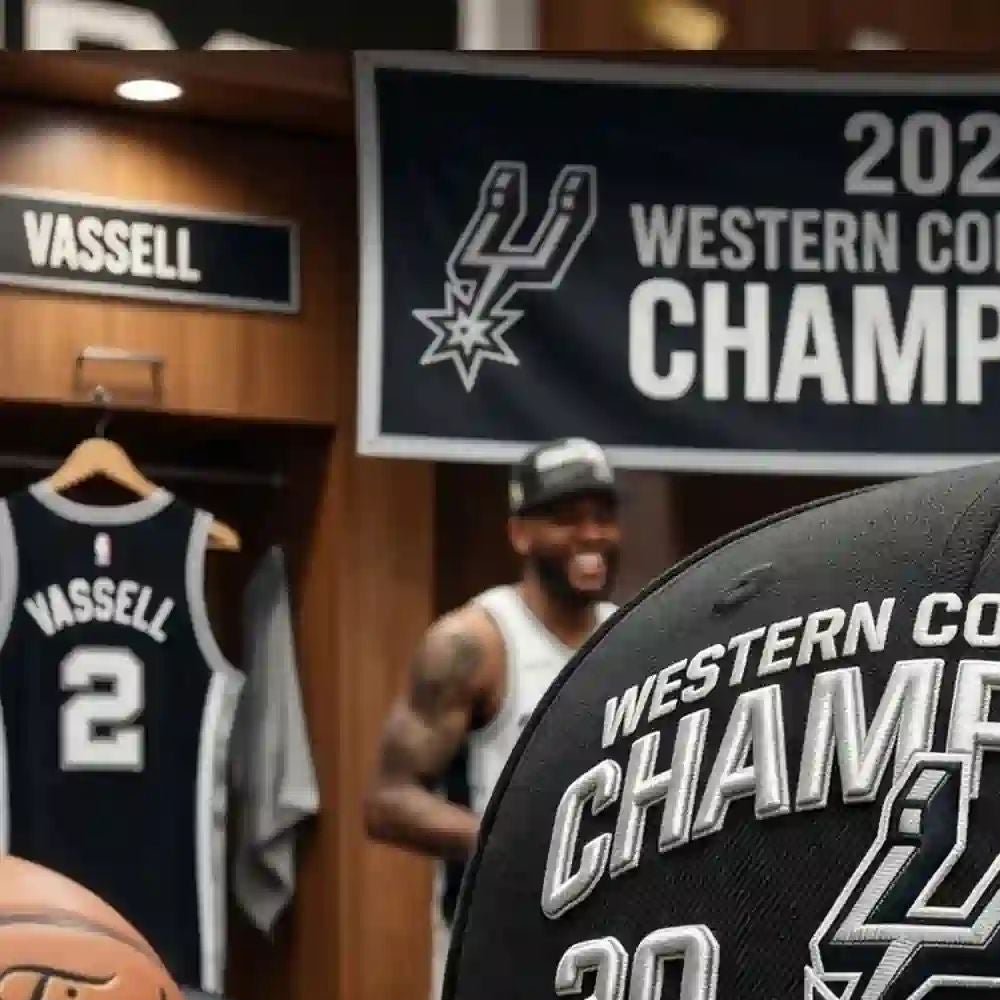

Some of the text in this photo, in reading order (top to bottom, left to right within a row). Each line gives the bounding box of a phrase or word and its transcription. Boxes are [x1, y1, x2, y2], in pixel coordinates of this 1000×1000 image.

[23, 210, 201, 282] VASSELL
[629, 203, 899, 273] WESTERN
[23, 576, 175, 643] VASSELL
[60, 645, 145, 772] 2
[602, 597, 896, 748] WESTERN
